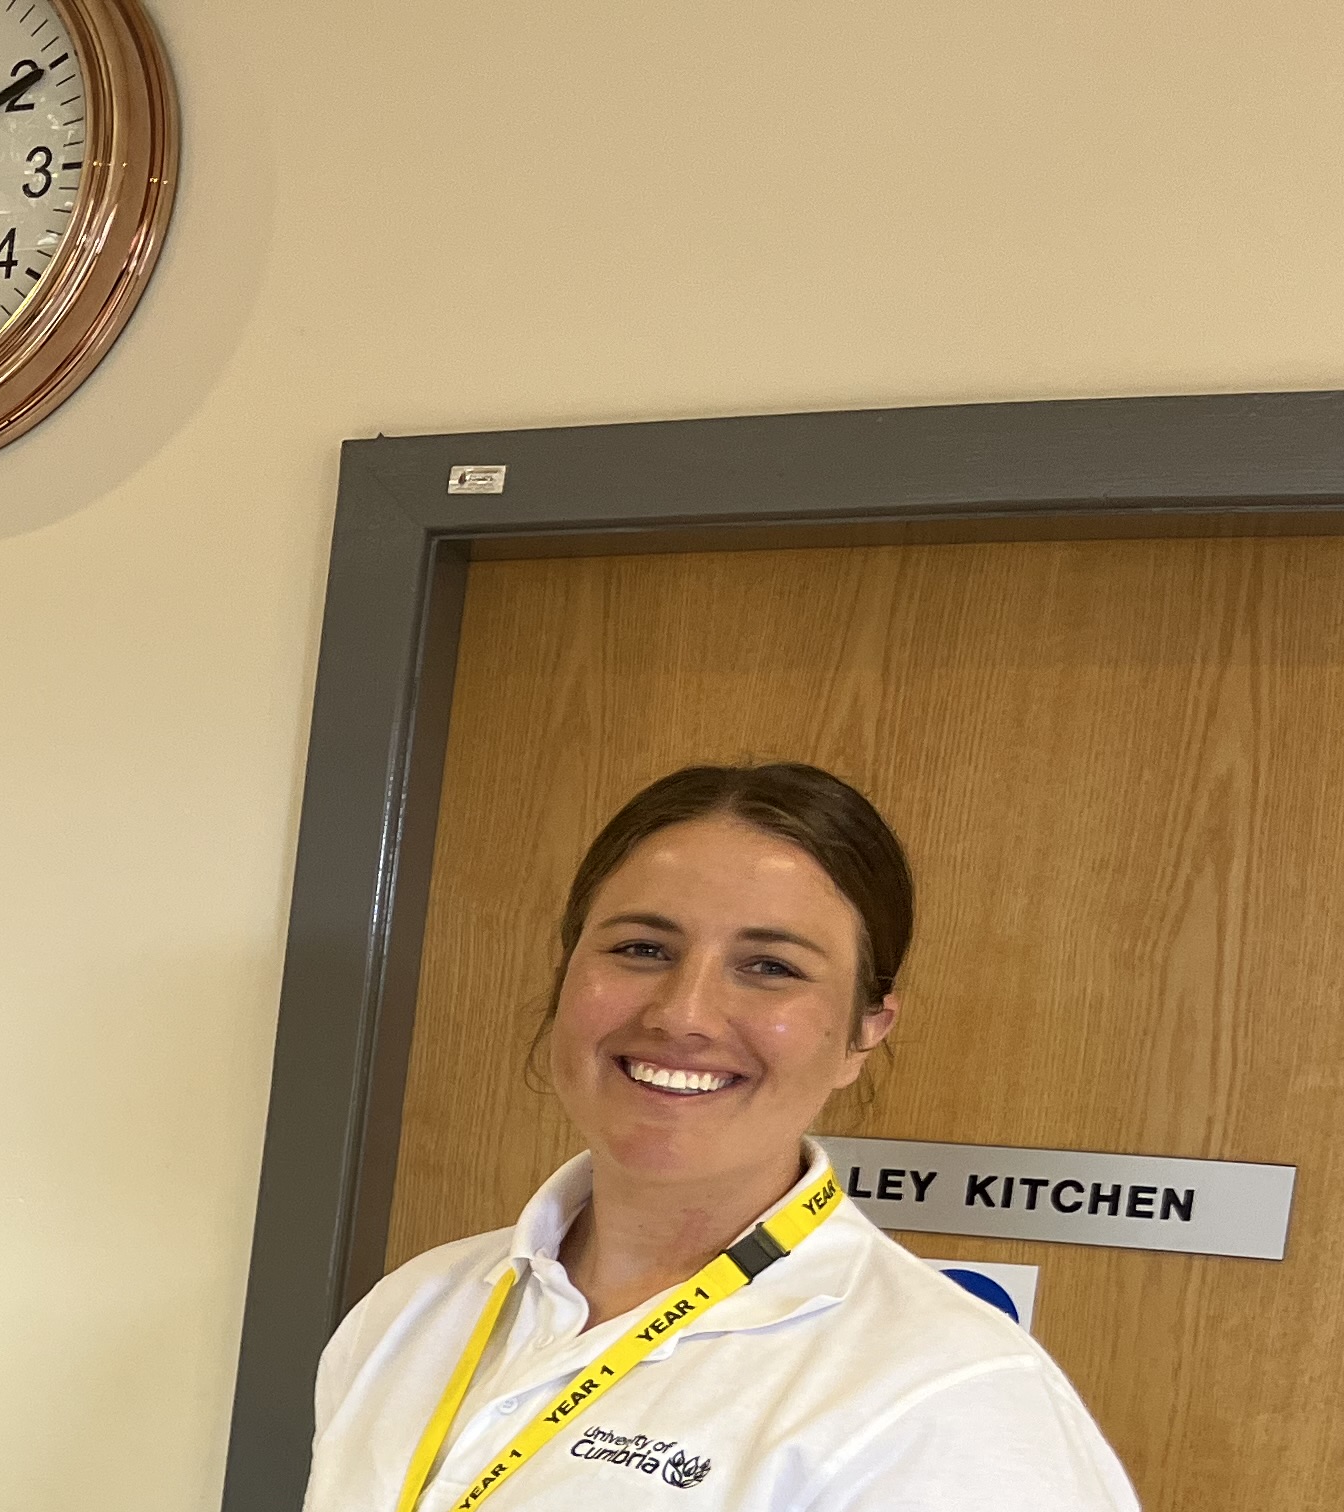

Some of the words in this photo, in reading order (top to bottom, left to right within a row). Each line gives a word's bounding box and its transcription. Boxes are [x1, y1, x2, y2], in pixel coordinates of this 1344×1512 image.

[22, 146, 53, 198] 3
[802, 1179, 836, 1216] YEAR
[965, 1174, 1195, 1223] KITCHEN
[635, 1298, 695, 1343] YEAR
[695, 1287, 711, 1304] 1
[544, 1376, 600, 1426] YEAR
[600, 1365, 615, 1379] 1
[570, 1438, 660, 1474] Cumbria
[653, 1441, 678, 1454] of
[459, 1463, 508, 1511] YEAR
[509, 1449, 523, 1460] 1
